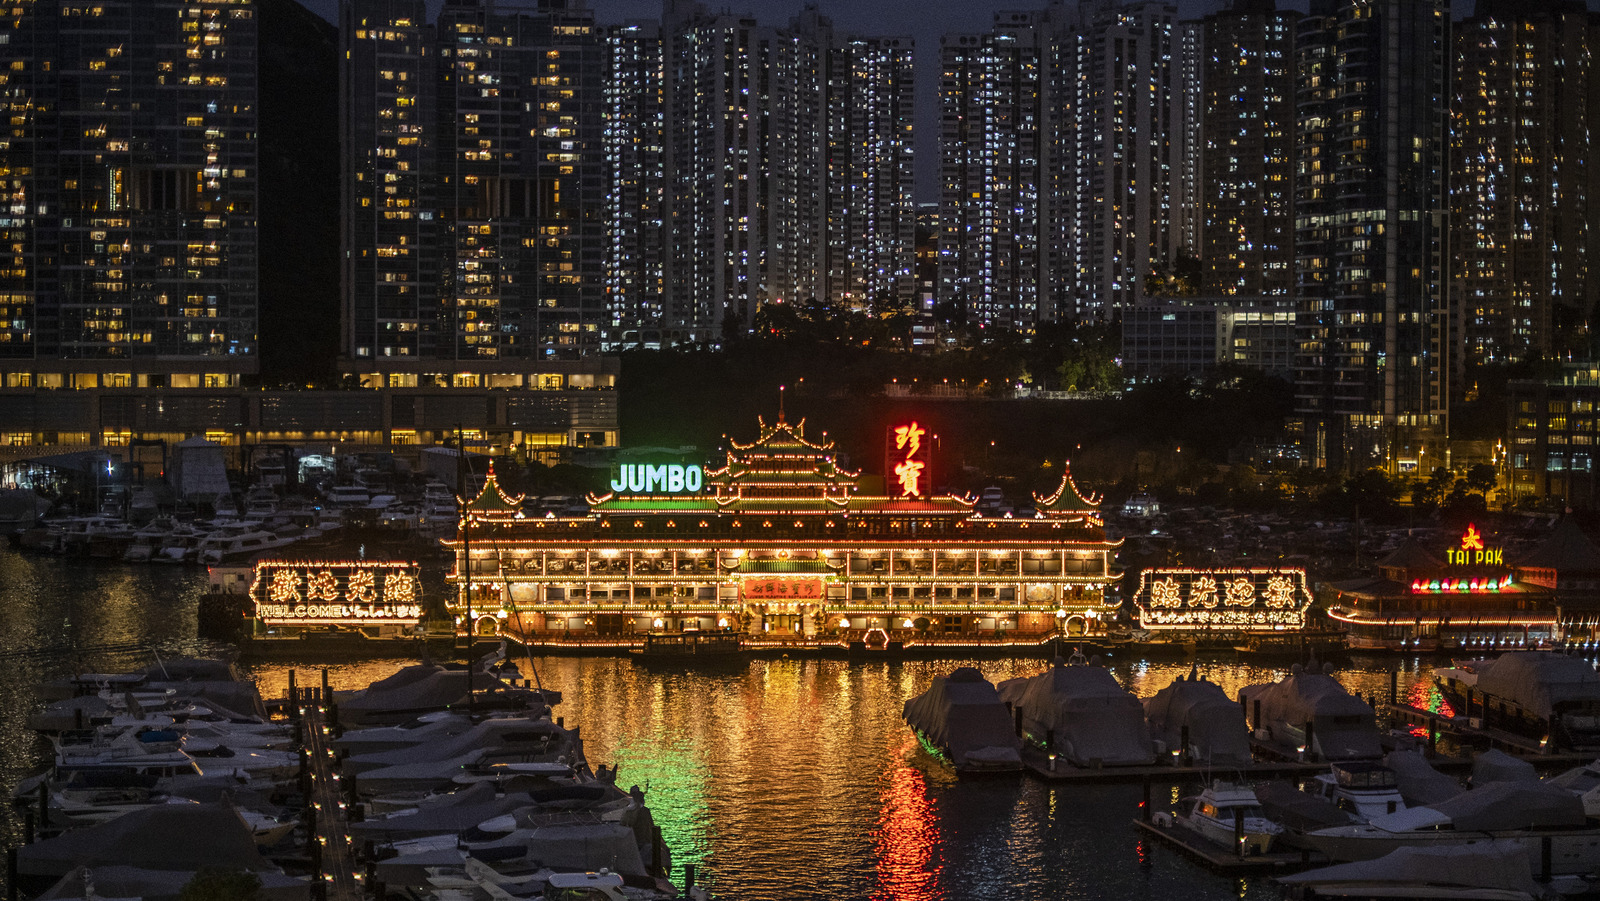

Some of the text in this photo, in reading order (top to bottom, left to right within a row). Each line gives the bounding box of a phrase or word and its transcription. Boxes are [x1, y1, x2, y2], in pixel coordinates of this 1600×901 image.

[894, 421, 926, 497] 珍寶
[610, 463, 702, 492] JUMBO
[1461, 524, 1484, 549] 太
[1446, 549, 1503, 565] TAI PAK
[260, 604, 342, 618] WELCOME
